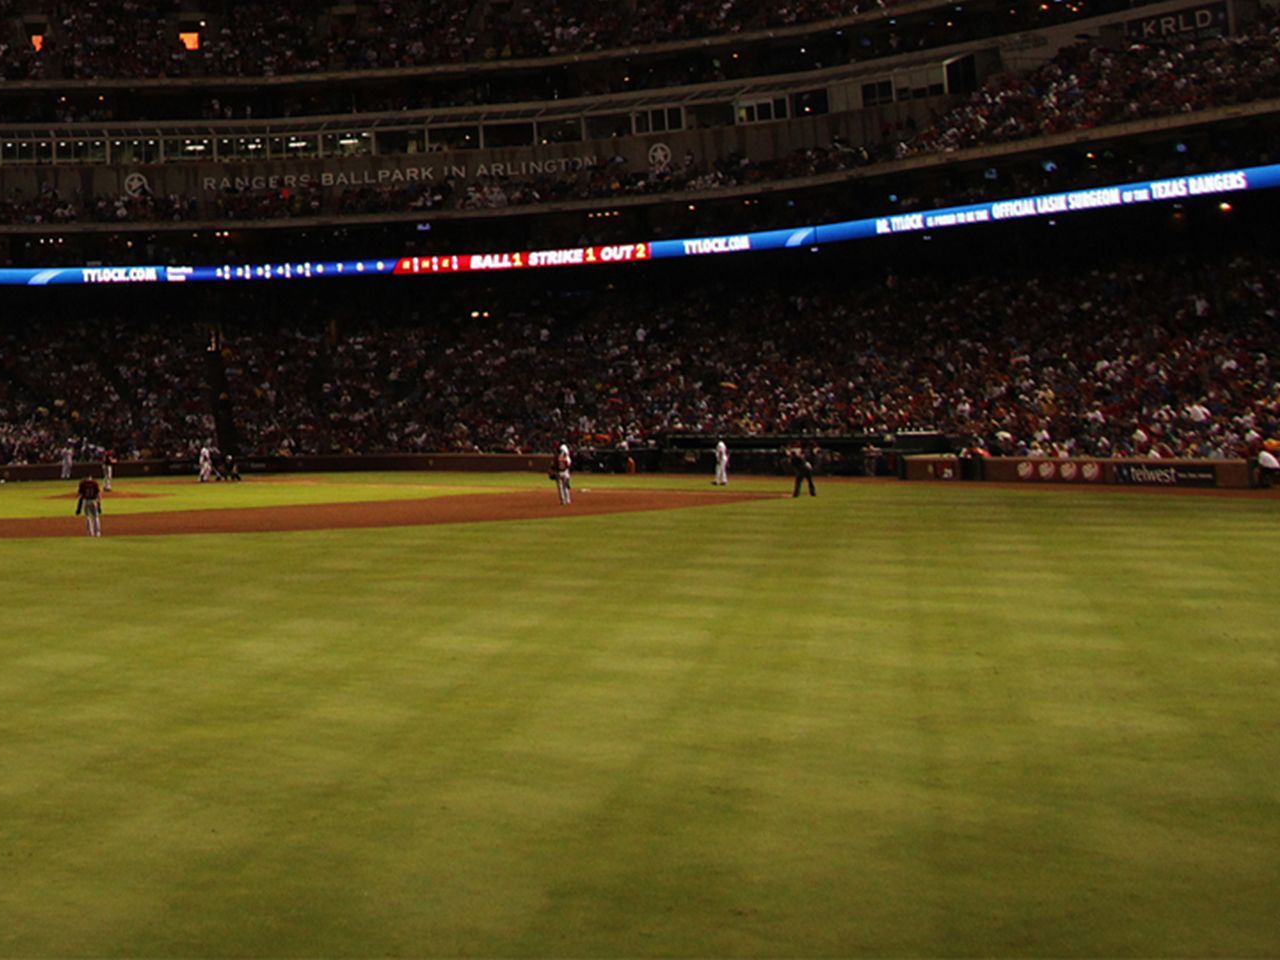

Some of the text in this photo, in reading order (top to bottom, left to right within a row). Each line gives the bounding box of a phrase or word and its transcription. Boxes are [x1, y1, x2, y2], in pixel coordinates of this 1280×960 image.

[1142, 9, 1213, 38] KRLD
[203, 155, 598, 190] RANGERS BALLPARK IN ARLINGTON
[991, 198, 1035, 220] OFFICIAL
[1036, 194, 1069, 214] LASIK
[1068, 188, 1120, 209] SURGEON
[1150, 178, 1187, 199] TEXAS
[1188, 171, 1247, 195] RANGERS
[470, 250, 512, 270] BALL
[513, 250, 523, 267] 1
[528, 247, 584, 266] STRIKE
[585, 247, 597, 262] 1
[600, 244, 635, 260] OUT
[636, 242, 647, 258] 2
[683, 235, 750, 255] TYLOCK.COM
[82, 268, 157, 283] TYLOCK.COM
